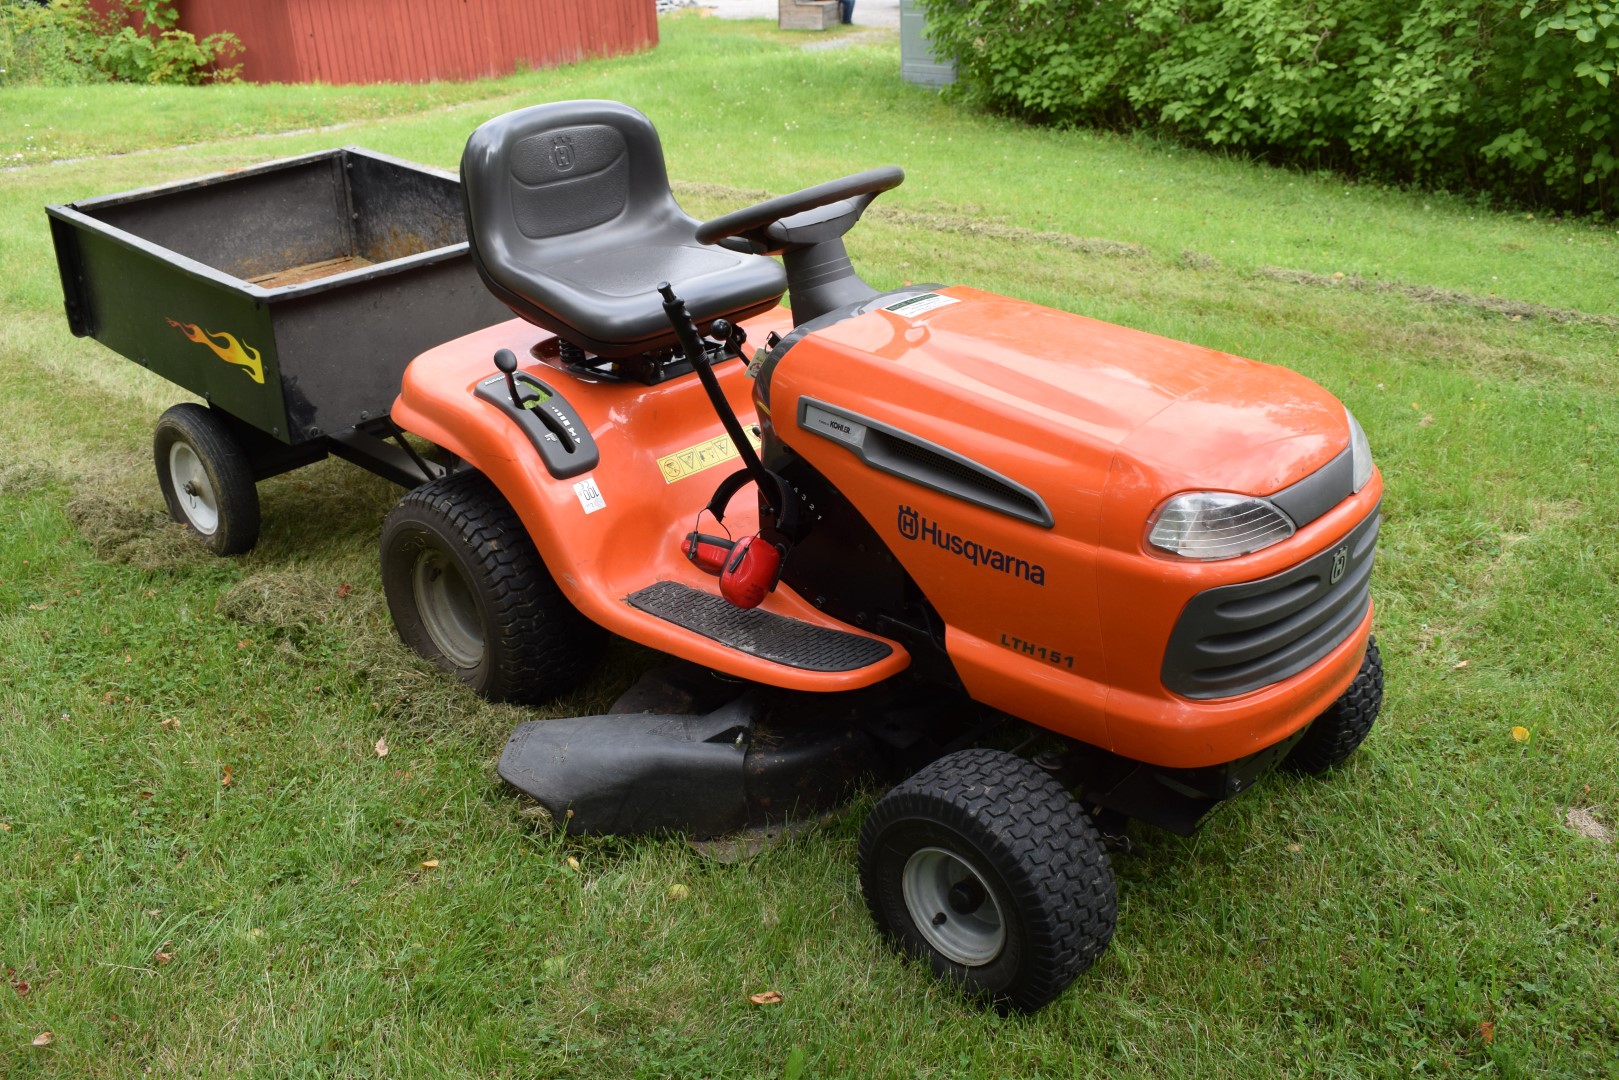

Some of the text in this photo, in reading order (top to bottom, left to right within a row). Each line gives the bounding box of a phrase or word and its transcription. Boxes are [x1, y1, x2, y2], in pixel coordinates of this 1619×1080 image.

[830, 420, 851, 434] KOHLER
[921, 517, 1045, 586] Husqvarna
[1001, 633, 1075, 668] LTH151
